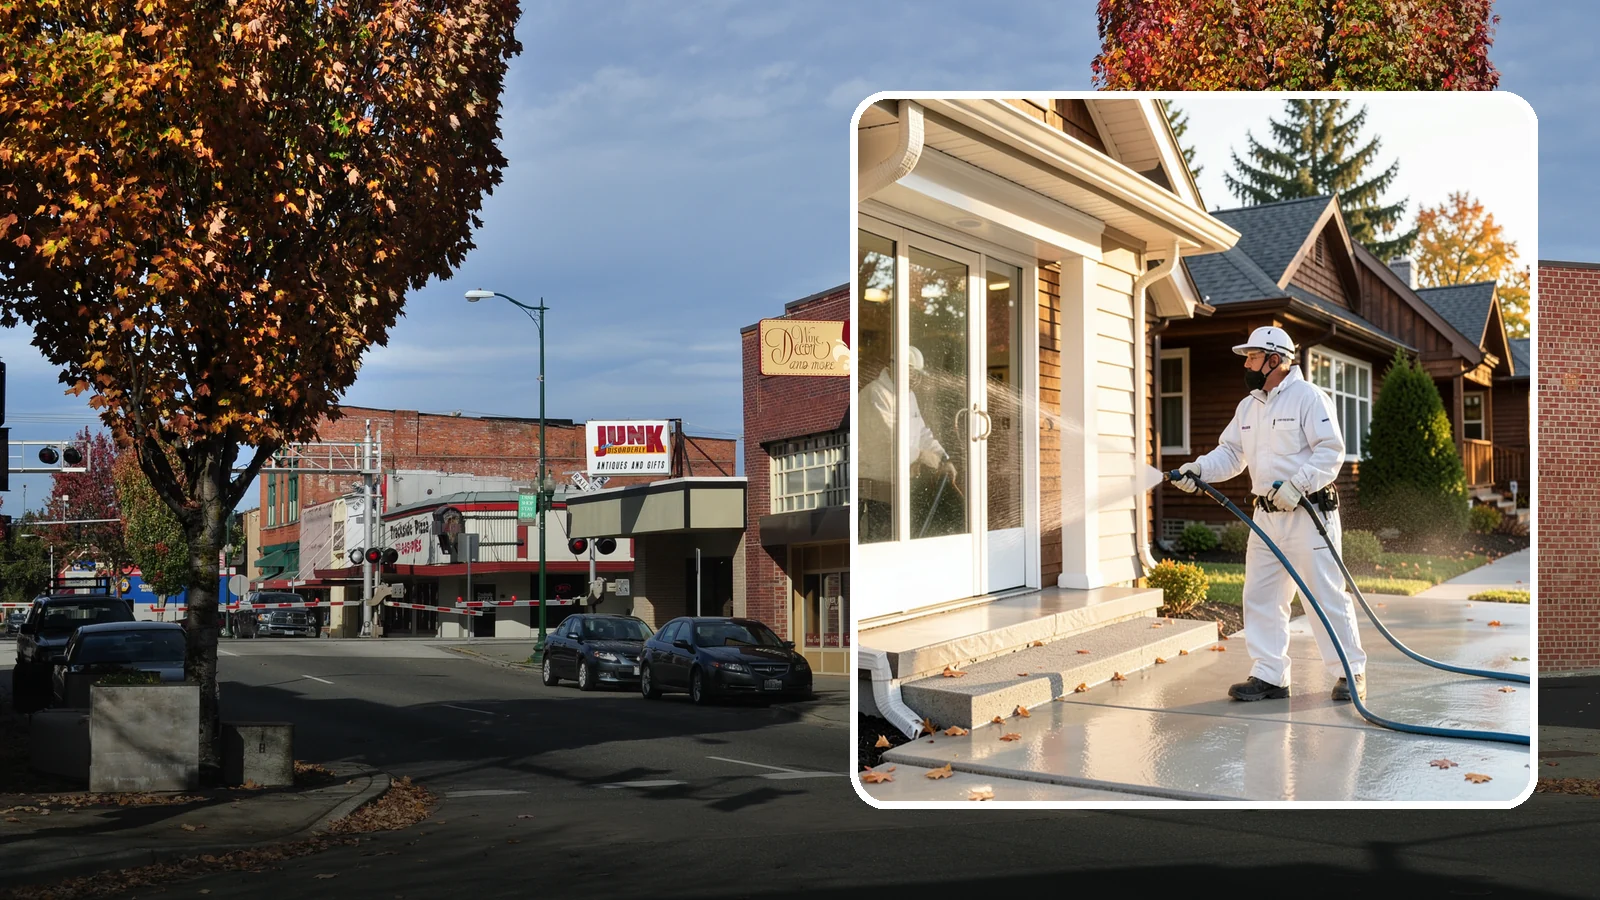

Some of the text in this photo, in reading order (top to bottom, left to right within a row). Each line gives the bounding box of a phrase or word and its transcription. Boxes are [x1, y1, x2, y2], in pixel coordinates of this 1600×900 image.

[765, 327, 831, 365] Decor
[596, 426, 664, 457] JUNK
[607, 446, 646, 454] DISORDERLY
[597, 460, 666, 470] ANTIQUES AND GIFTS
[390, 519, 429, 540] Trackside Pizza
